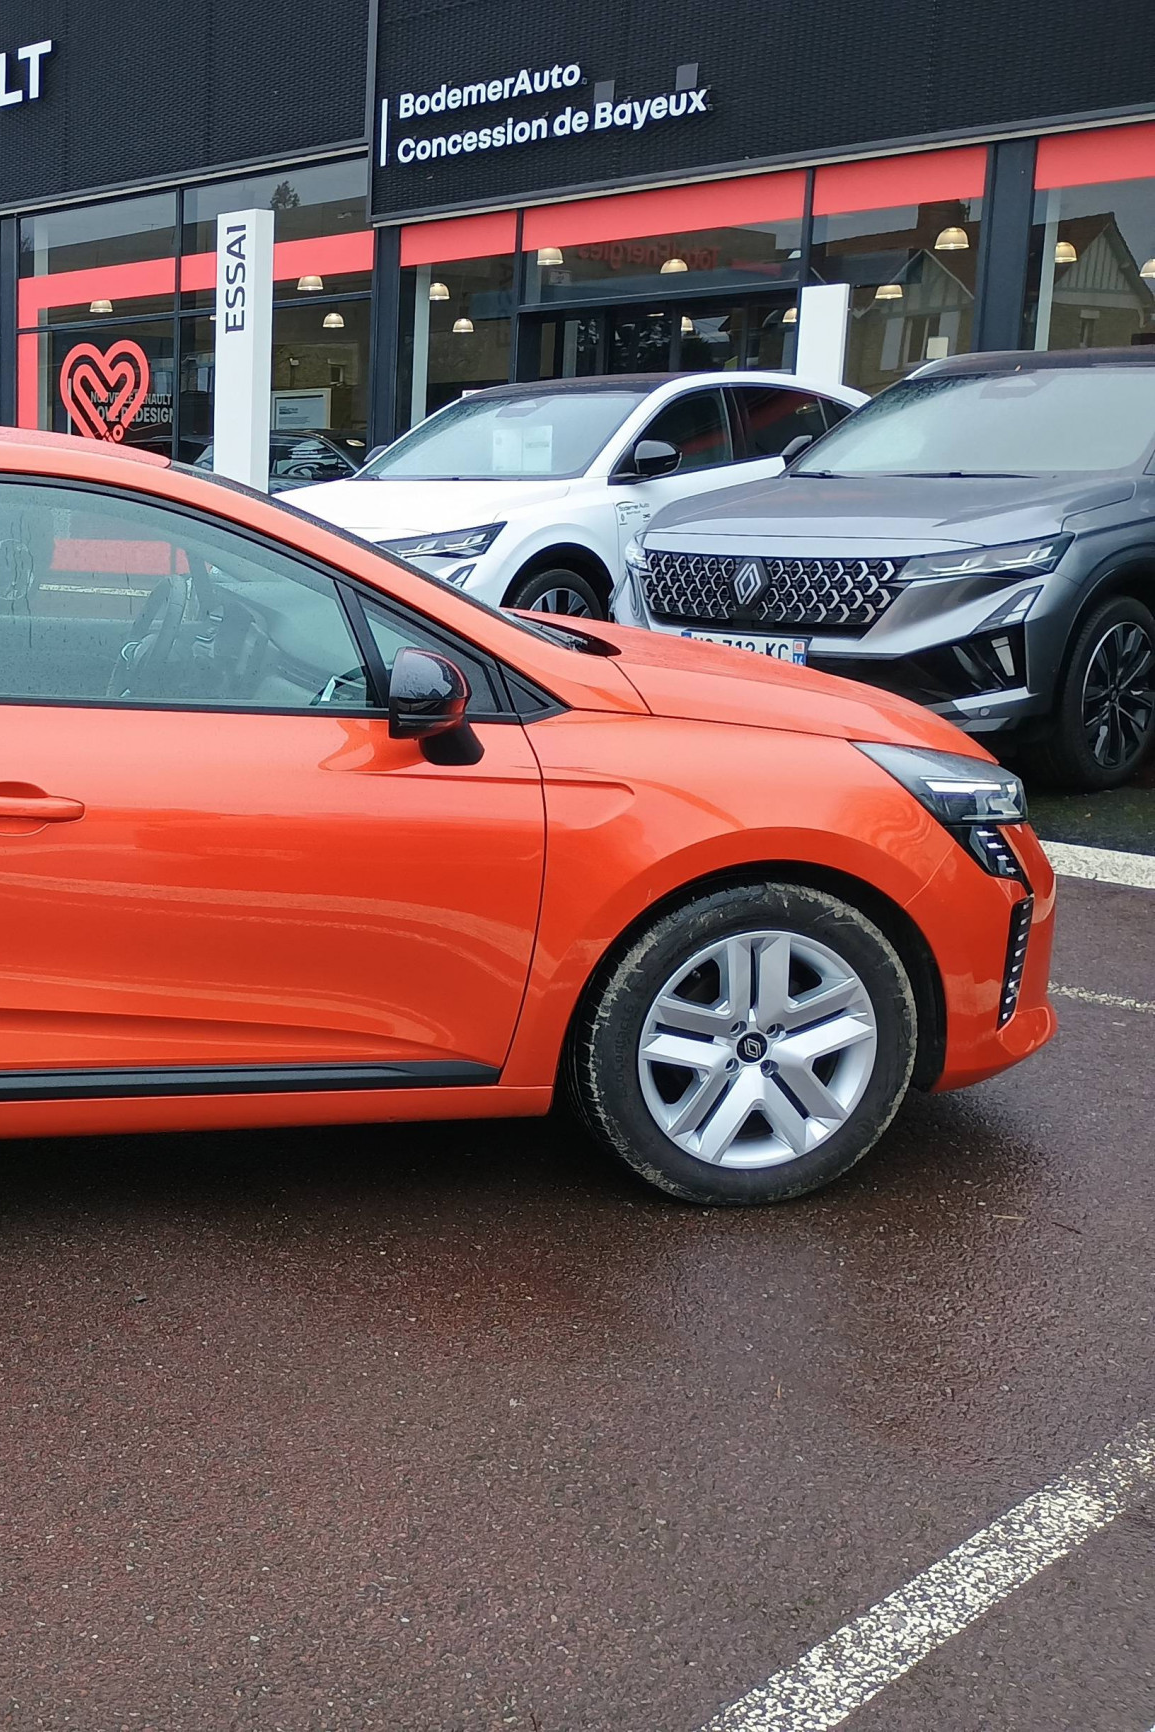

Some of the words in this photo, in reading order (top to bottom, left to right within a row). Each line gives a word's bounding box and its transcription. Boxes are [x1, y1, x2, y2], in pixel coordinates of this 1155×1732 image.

[397, 117, 548, 164] Concession
[552, 106, 589, 137] de
[595, 88, 708, 130] Bayeux
[398, 62, 582, 119] BodemerAuto
[225, 224, 246, 334] ESSAI
